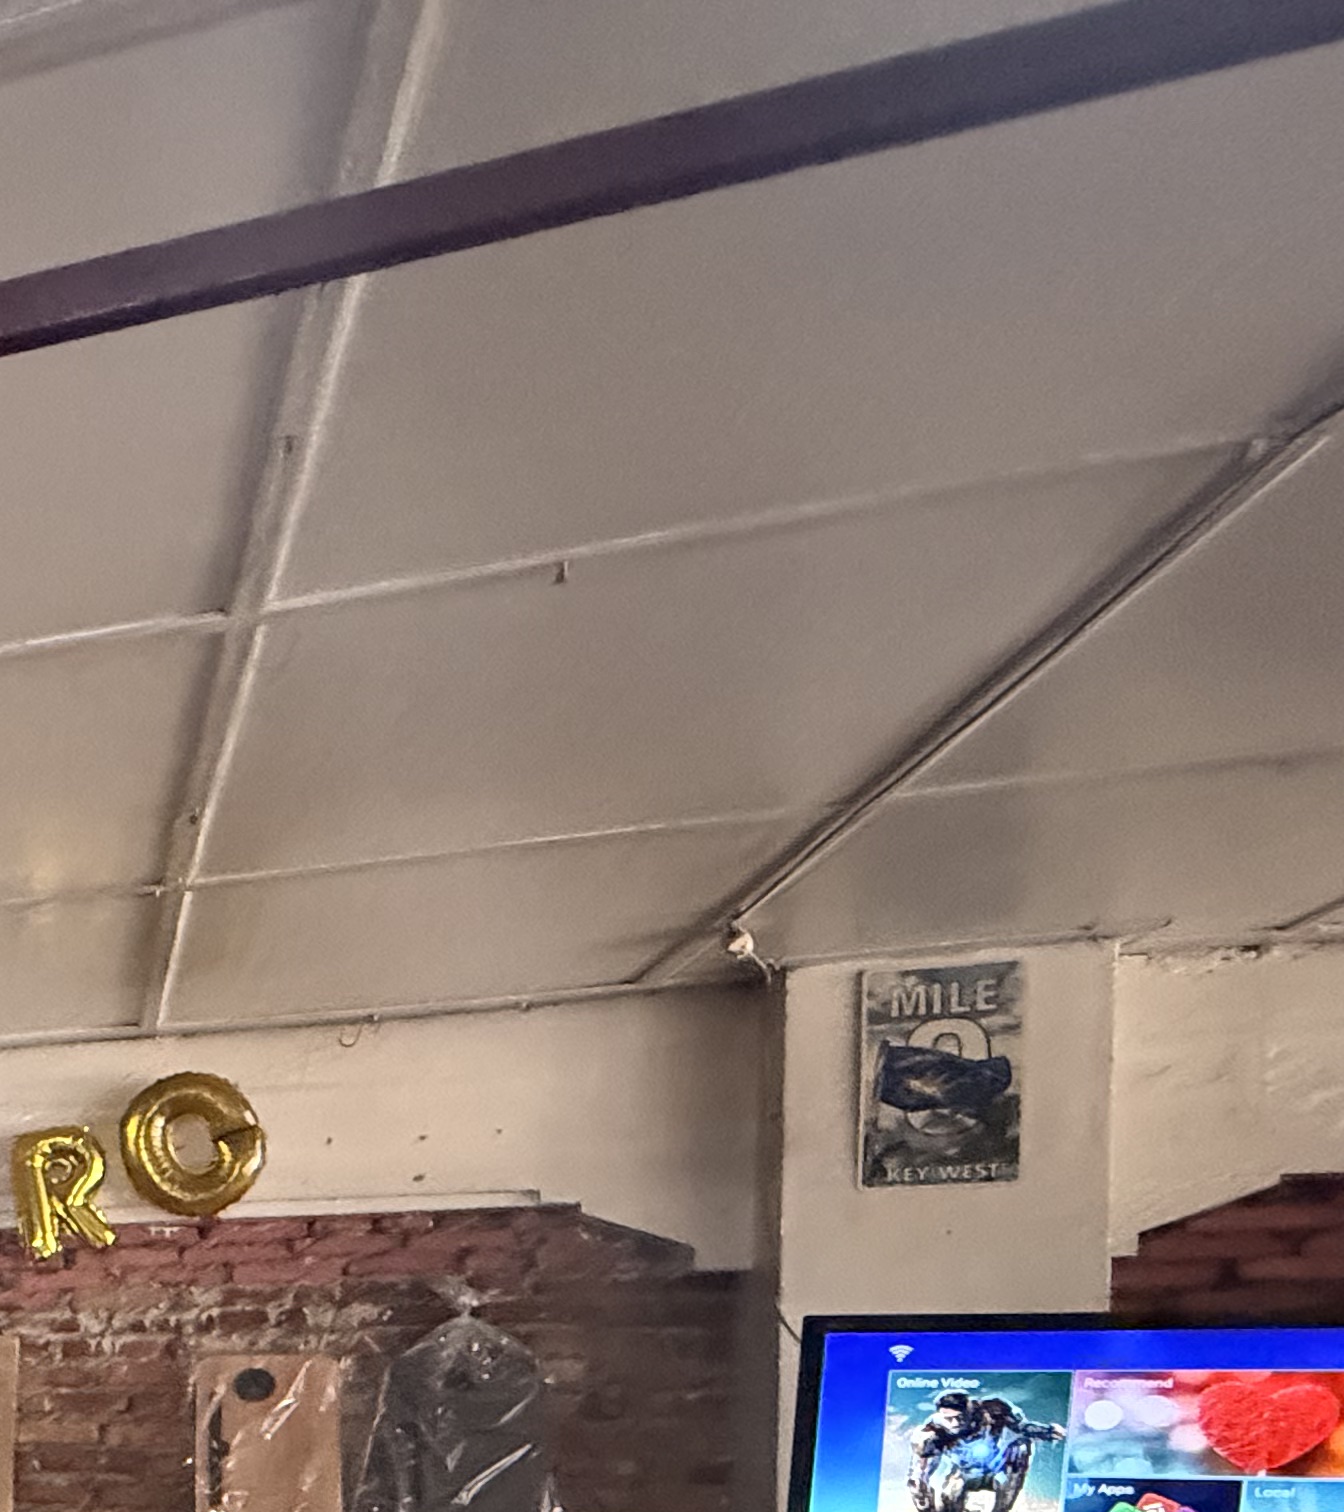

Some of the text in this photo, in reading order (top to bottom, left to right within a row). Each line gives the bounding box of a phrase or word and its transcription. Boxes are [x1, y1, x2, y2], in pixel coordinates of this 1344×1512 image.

[890, 979, 998, 1017] MILE
[886, 1163, 999, 1182] KEY WEST
[896, 1376, 981, 1389] Online Video
[1097, 1483, 1136, 1497] Apps
[1254, 1485, 1296, 1499] Local
